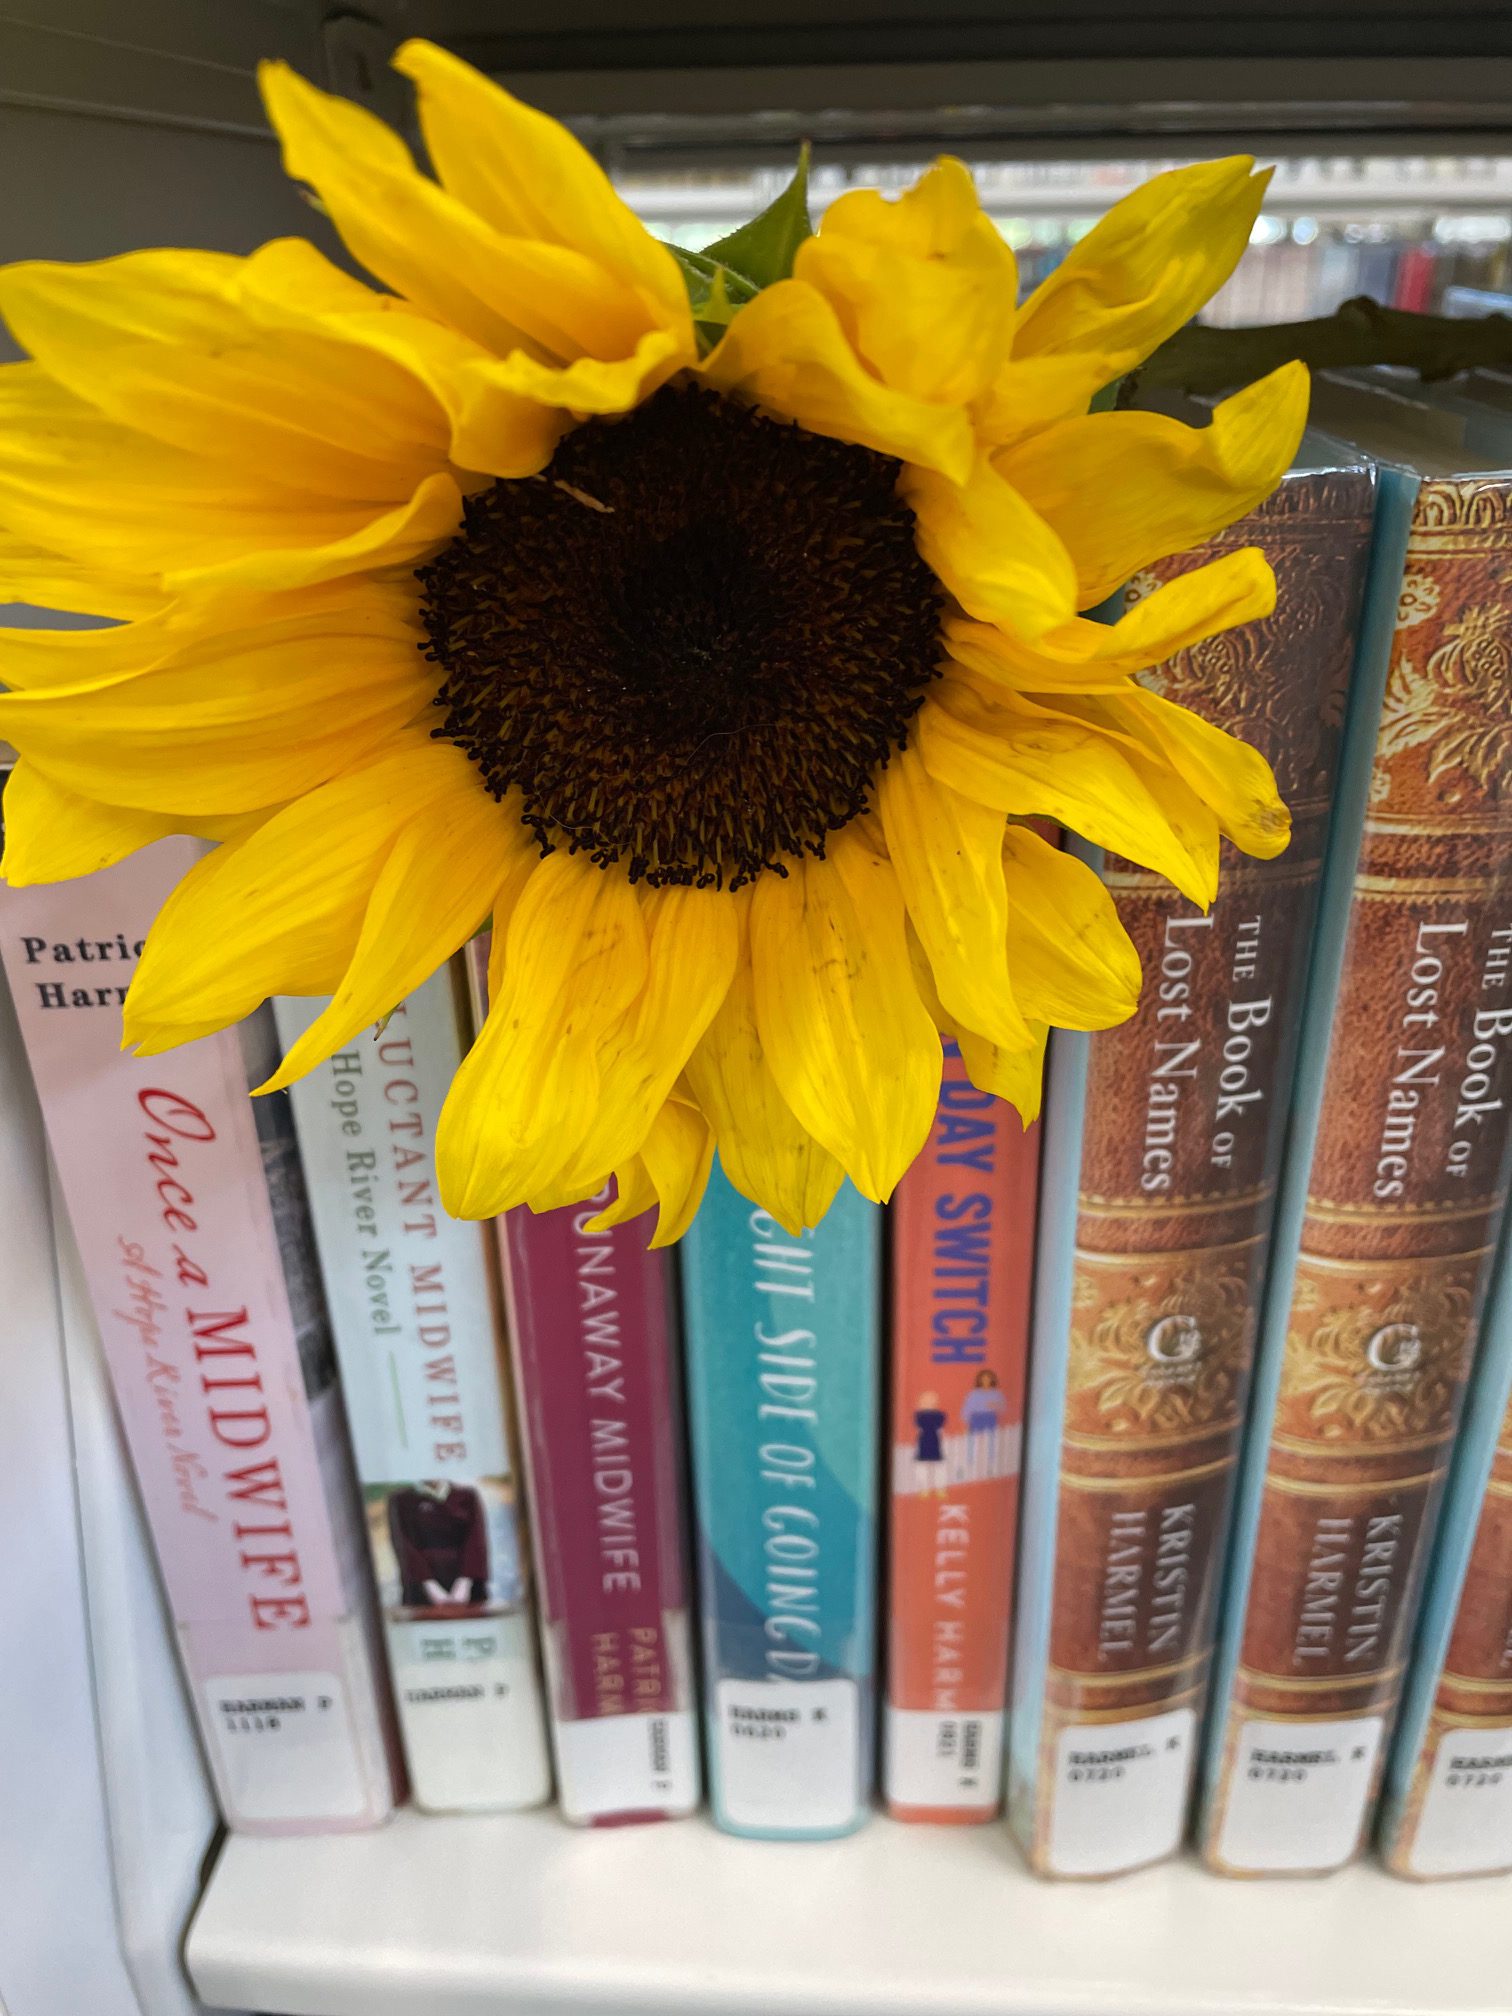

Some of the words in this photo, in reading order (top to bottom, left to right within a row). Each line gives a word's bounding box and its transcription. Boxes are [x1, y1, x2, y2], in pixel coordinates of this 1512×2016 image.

[1156, 914, 1214, 1022] Lost
[1402, 919, 1469, 1029] Lost
[138, 1086, 216, 1232] Once
[331, 1048, 364, 1138] Hope
[935, 1081, 996, 1174] DAY
[1141, 1038, 1201, 1192] Names
[1373, 1044, 1446, 1199] Names
[172, 1243, 209, 1289] a
[346, 1149, 377, 1239] River
[374, 1003, 438, 1241] UCTANT
[411, 1263, 467, 1463] MIDWIFE
[362, 1249, 402, 1337] Novel
[930, 1193, 994, 1365] SWITCH
[755, 1320, 820, 1420] SIDE
[187, 1305, 310, 1632] MIDWIFE
[591, 1419, 642, 1594] MIDWIFE
[759, 1442, 816, 1489] OF
[934, 1503, 972, 1610] KELLY
[1099, 1510, 1147, 1662] HARMEL
[1148, 1502, 1197, 1654] KRISTIN
[1292, 1517, 1353, 1667] HARMEL
[1343, 1513, 1404, 1663] KRISTIN
